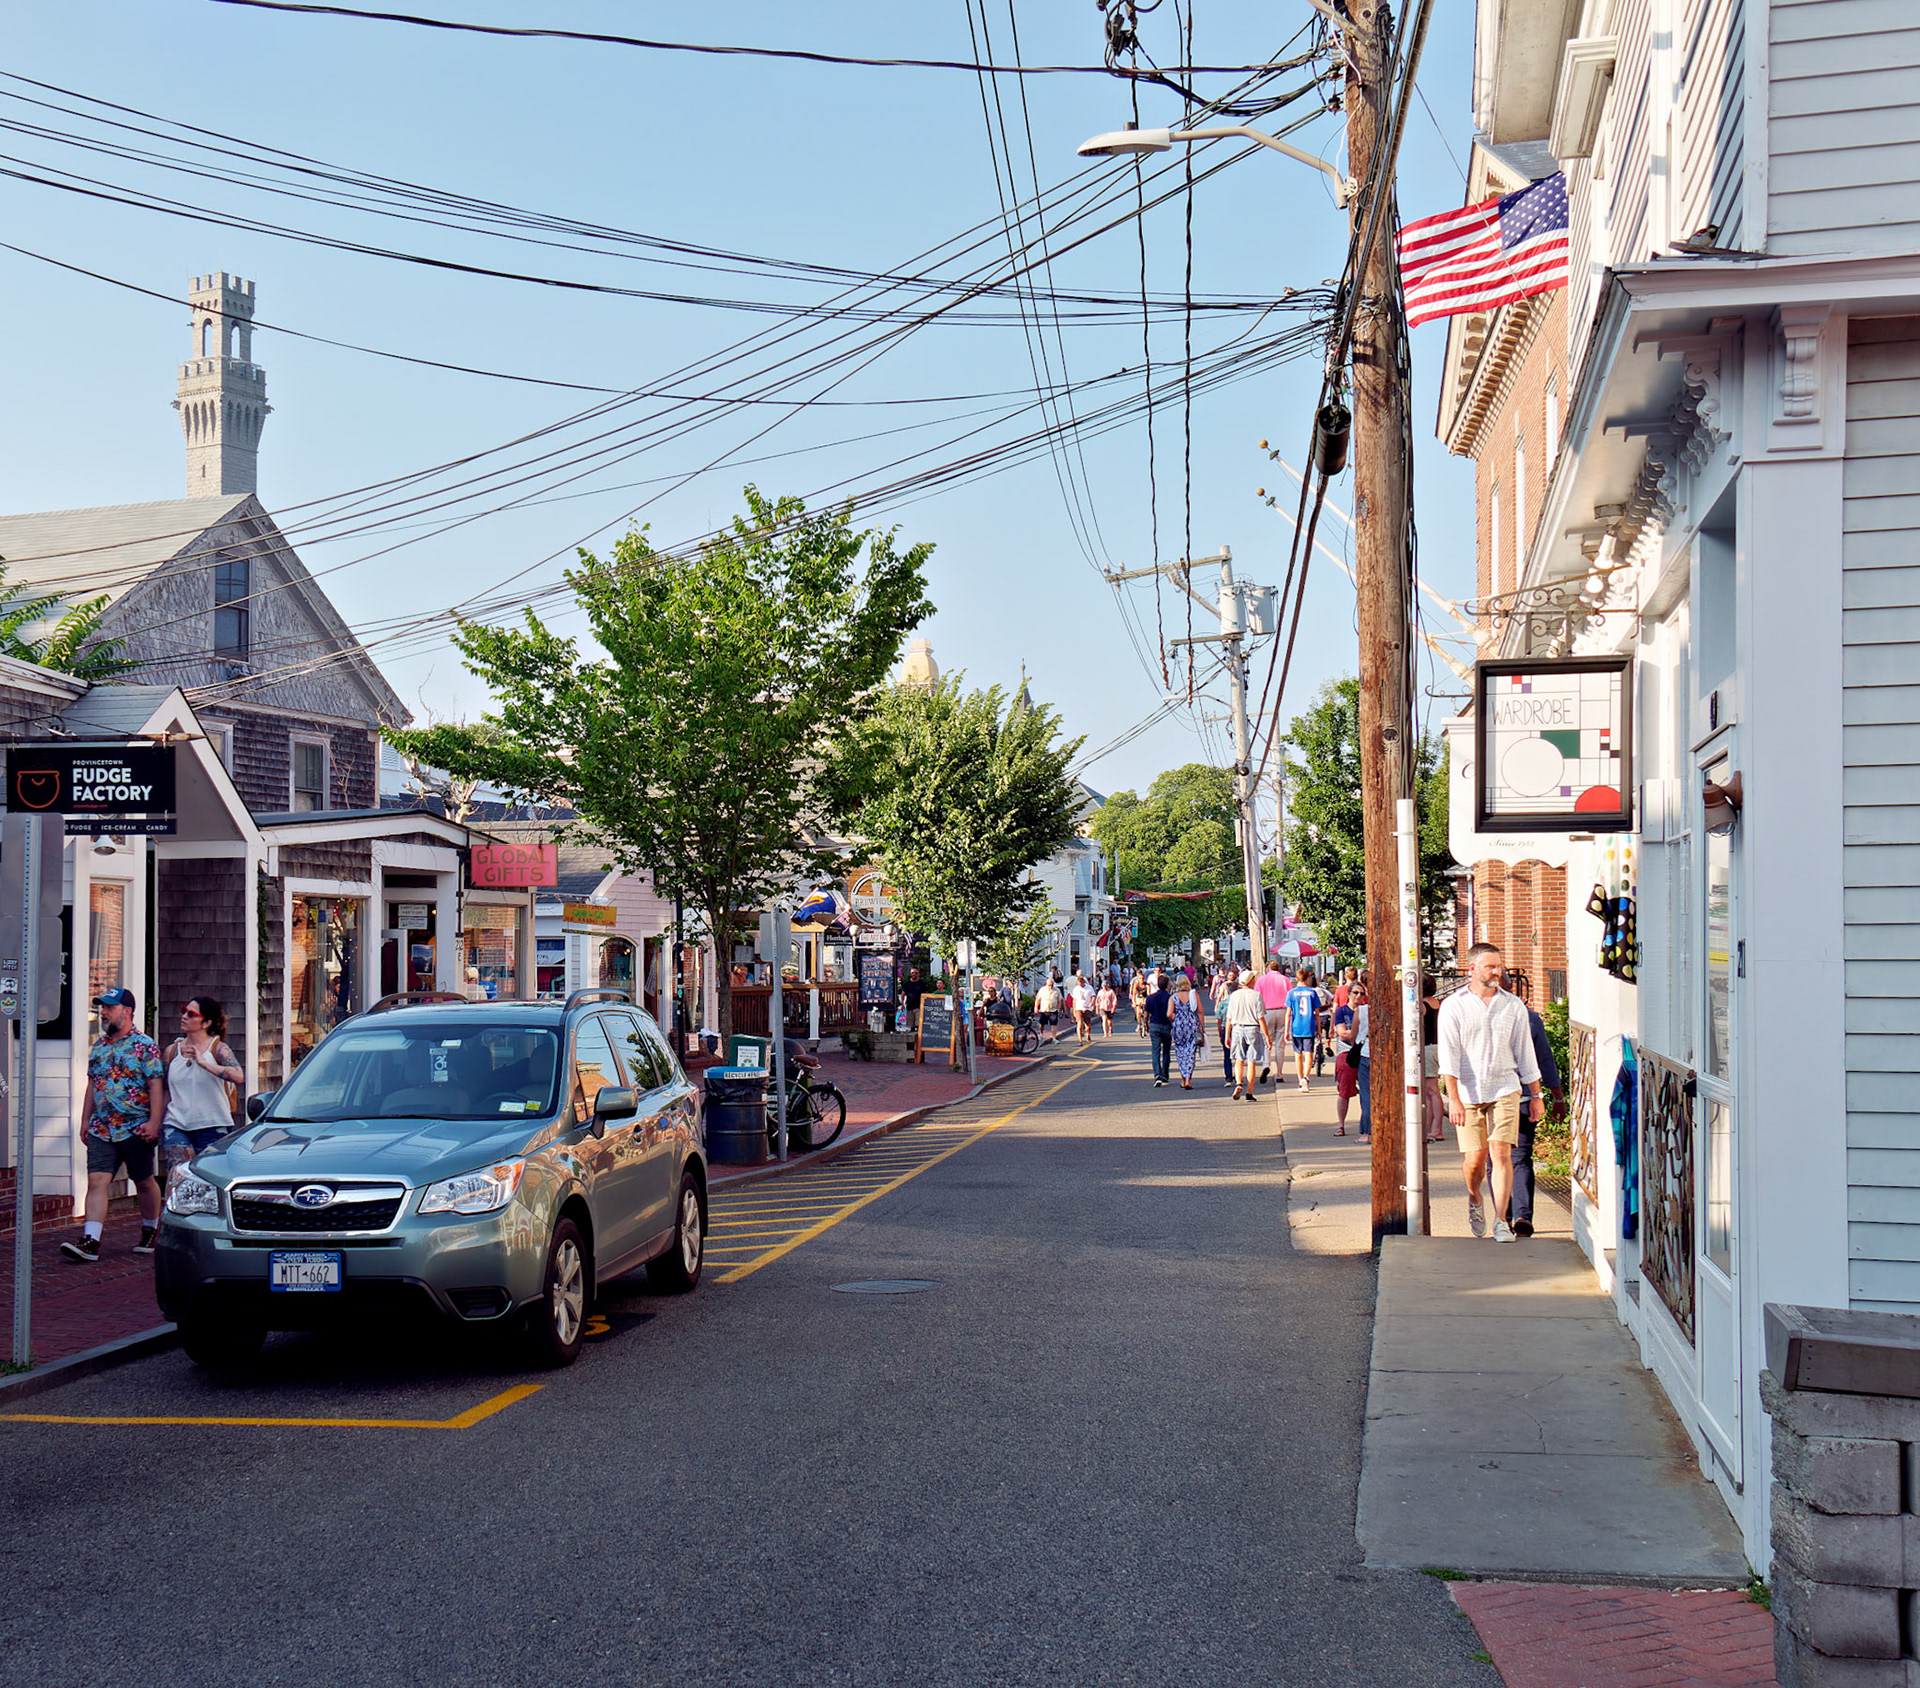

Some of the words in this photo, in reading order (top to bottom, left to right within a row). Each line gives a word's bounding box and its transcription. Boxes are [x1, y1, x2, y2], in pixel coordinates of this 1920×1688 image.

[1491, 698, 1574, 725] WARDROBE
[72, 768, 132, 783] FUDGE
[72, 785, 153, 801] FACTORY
[476, 849, 550, 864] GLOBAL
[484, 867, 544, 882] GIFTS
[1299, 996, 1308, 1016] 9
